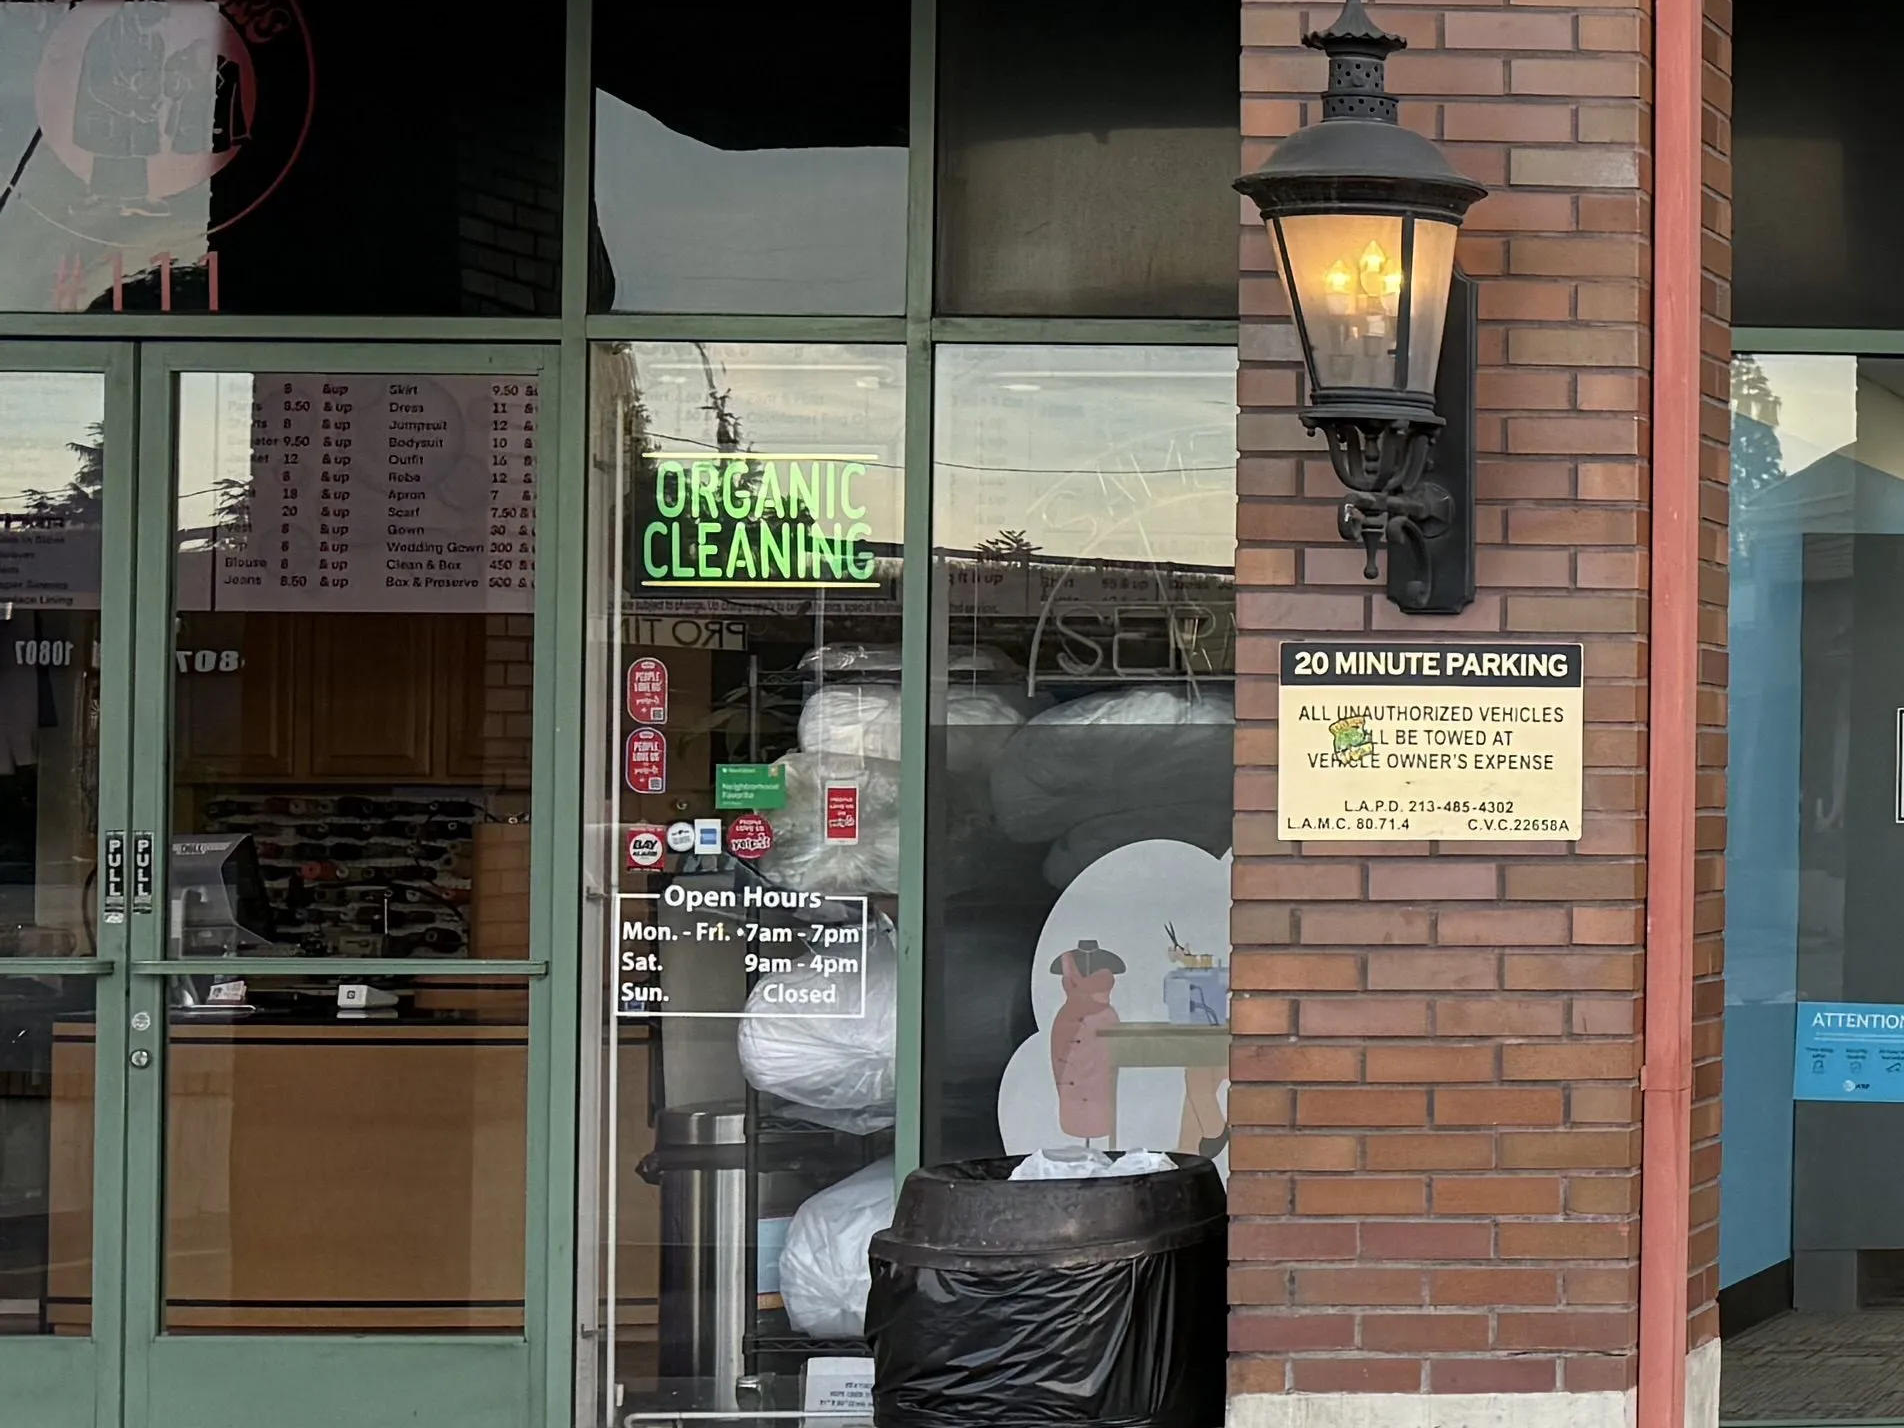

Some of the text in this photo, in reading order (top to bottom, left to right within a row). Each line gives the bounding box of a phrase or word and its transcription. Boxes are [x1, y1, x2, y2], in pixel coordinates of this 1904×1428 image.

[53, 251, 219, 312] #111
[388, 385, 519, 396] Skirt 9.50
[389, 402, 508, 414] Dress 11
[388, 420, 508, 432] Jumpsuit 12
[283, 436, 310, 447] 9.50
[388, 437, 507, 449] Bodysuit 10
[283, 453, 299, 464] 12
[388, 454, 507, 465] Outfit 16
[388, 472, 508, 483] Robe 12
[283, 488, 298, 499] 18
[388, 490, 499, 502] Apron 7
[656, 461, 866, 519] ORGANIC
[282, 506, 297, 516] 20
[388, 507, 517, 518] Scarf 7.50
[387, 524, 425, 535] Gown
[386, 542, 513, 554] Wedding Gown 300
[644, 522, 875, 580] CLEANING
[224, 557, 267, 568] Blouse
[386, 559, 512, 570] Clean Box 450
[224, 575, 261, 586] Jeans
[320, 576, 329, 587] &
[332, 578, 348, 588] up
[386, 576, 512, 587] Box & Preserve 500
[1294, 652, 1568, 677] 20 MINUTE PARKING
[1299, 705, 1564, 723] ALL UNAUTHORIZED VEHICLES
[1396, 730, 1418, 745] BE
[1423, 730, 1487, 746] TOWED
[1492, 731, 1513, 746] AT
[1387, 754, 1468, 769] OWNER'S
[1474, 754, 1554, 770] EXPENSE
[1345, 800, 1514, 813] L.A.P.D. 213-485-4302
[1287, 817, 1569, 832] L.A.M.C. 80.71.4 C.V.C.22658A
[633, 839, 658, 850] BAY
[109, 839, 121, 897] PULL
[138, 839, 150, 897] PULL
[664, 885, 822, 912] Open Hours
[622, 922, 678, 941] Mon.
[697, 923, 731, 941] Fri.
[746, 924, 792, 942] 7am
[811, 924, 860, 947] 7pm
[621, 952, 663, 972] Sat.
[745, 953, 792, 973] 9am
[810, 955, 858, 977] 4pm
[621, 982, 836, 1003] Sun. Closed
